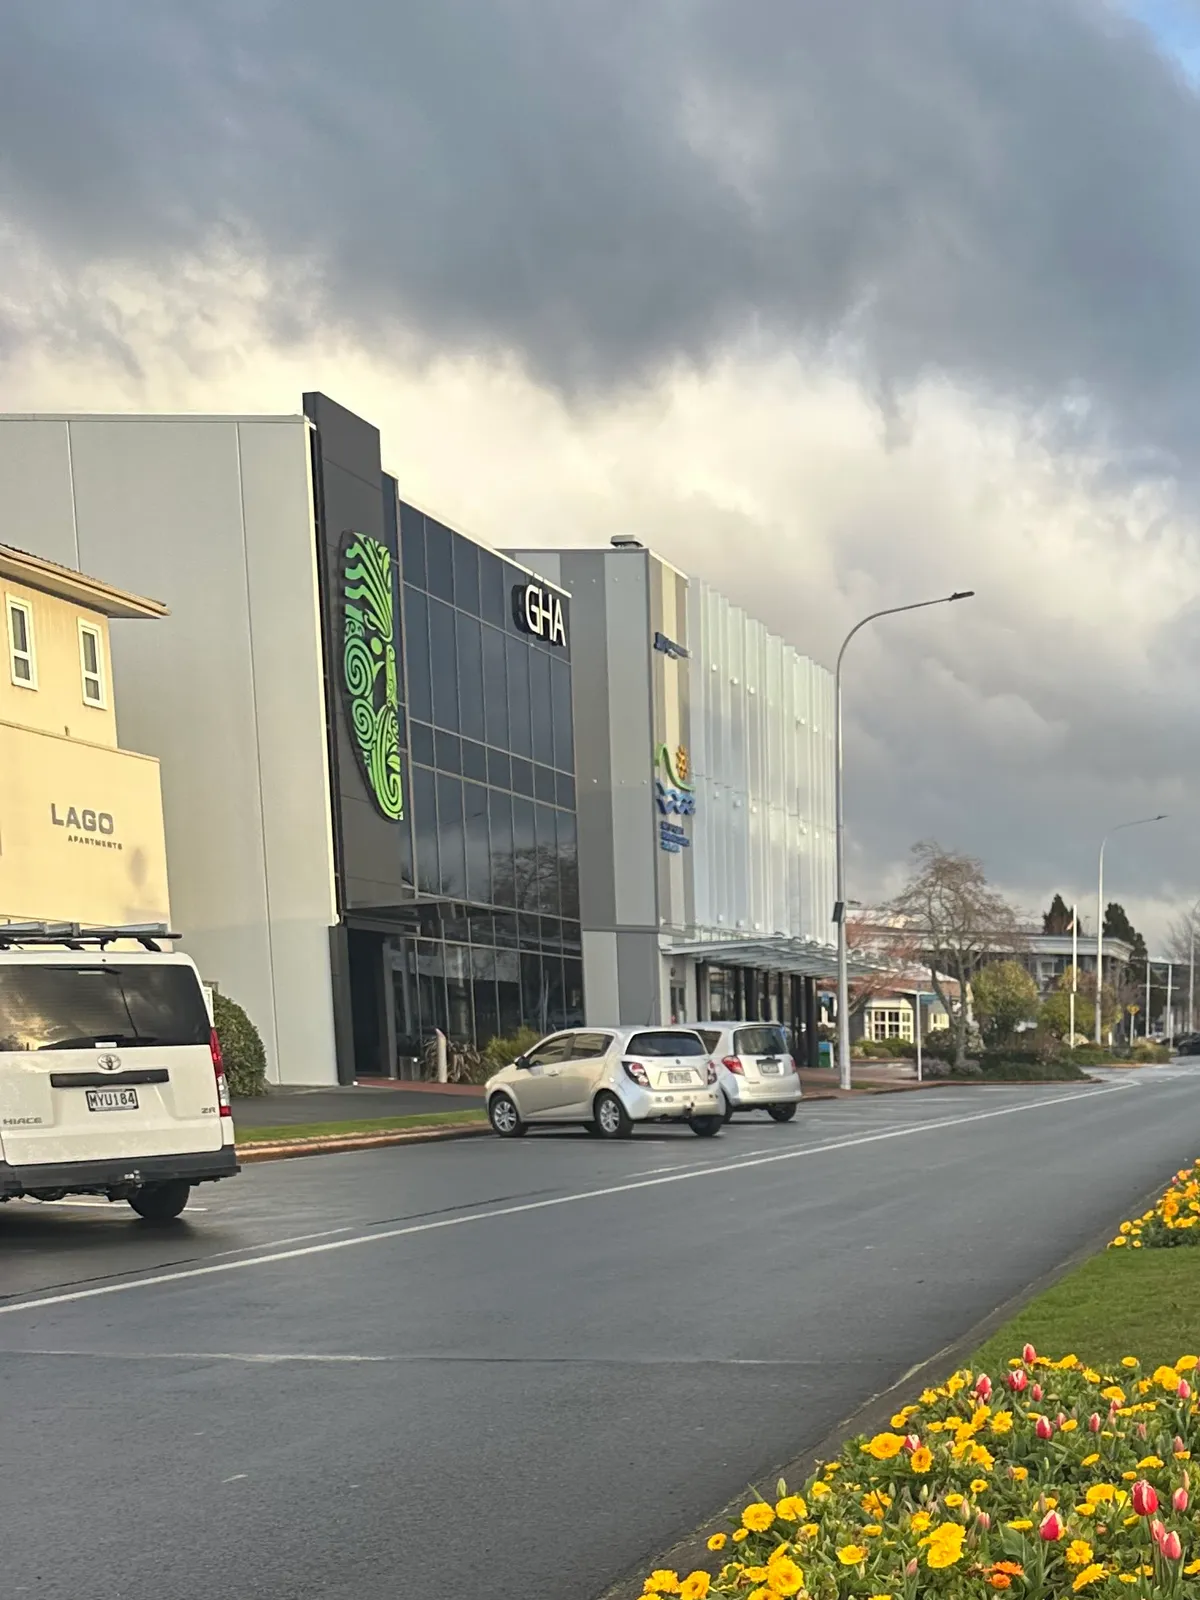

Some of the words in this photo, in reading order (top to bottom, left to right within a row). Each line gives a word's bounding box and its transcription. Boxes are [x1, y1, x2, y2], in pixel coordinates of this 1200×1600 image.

[525, 584, 567, 647] GHA
[51, 802, 114, 835] LAGO
[68, 834, 123, 850] APARTMENTS
[89, 1091, 136, 1107] MYU184
[201, 1106, 216, 1114] ZR
[3, 1116, 42, 1125] HIACE
